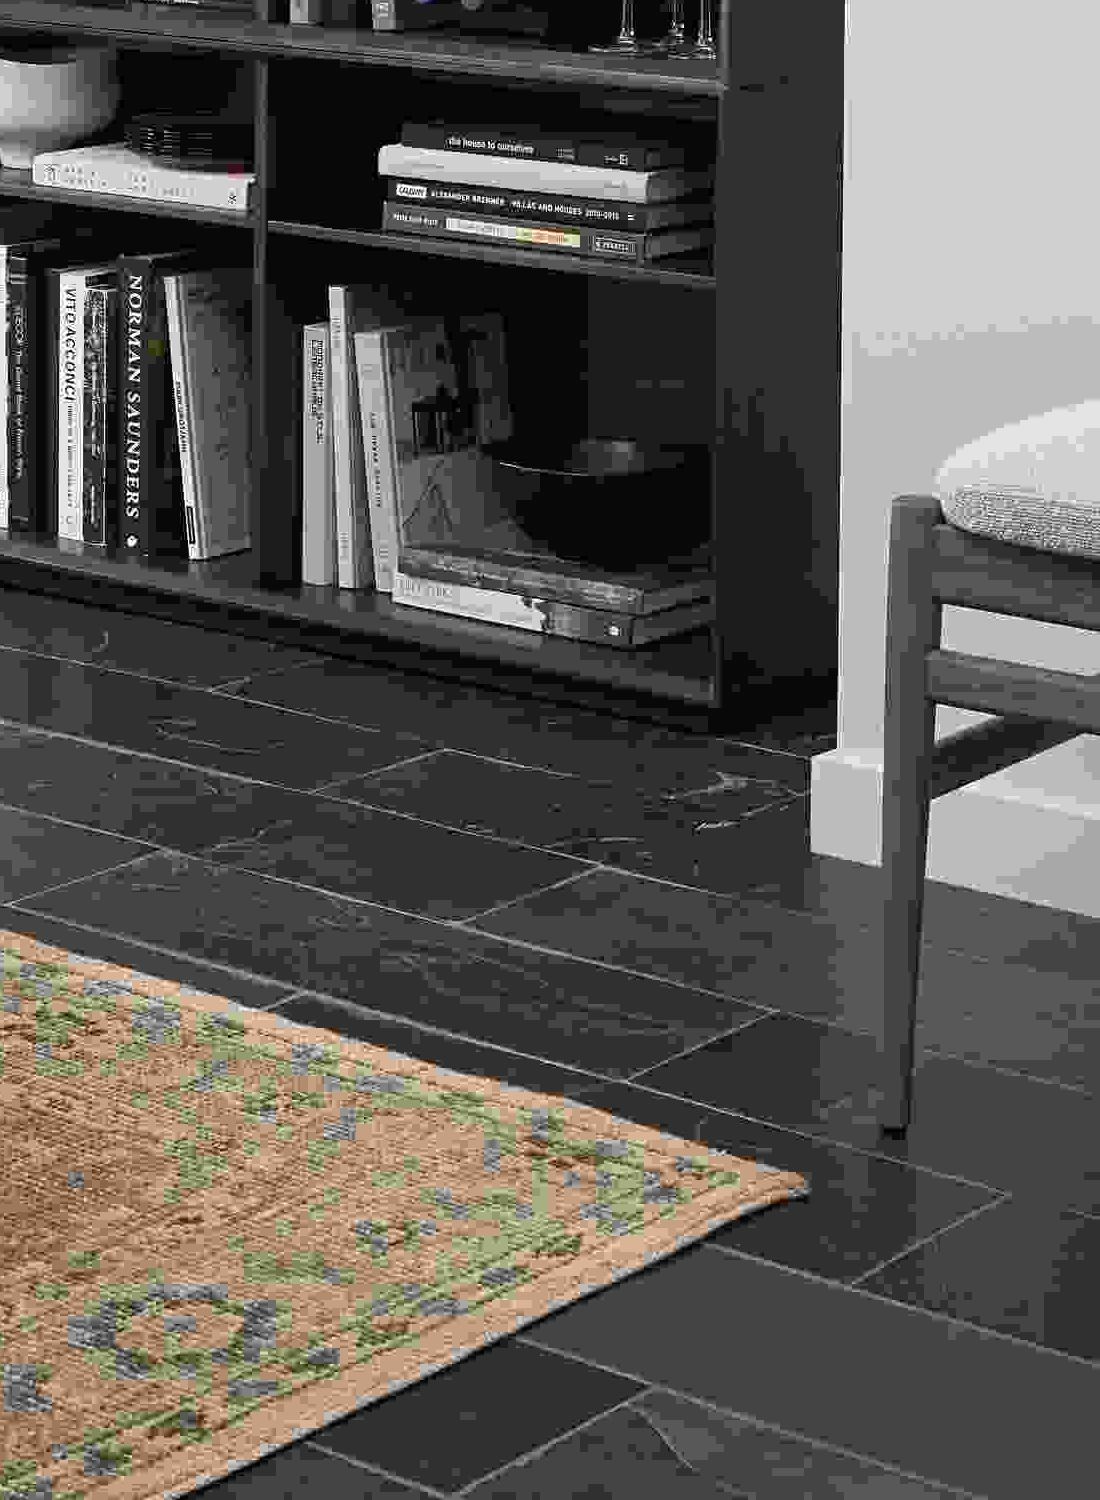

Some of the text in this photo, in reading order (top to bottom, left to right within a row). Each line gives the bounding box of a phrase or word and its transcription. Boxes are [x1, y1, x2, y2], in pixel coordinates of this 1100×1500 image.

[64, 287, 77, 324] VITO
[63, 326, 77, 401] ACCONCI
[126, 275, 142, 518] NORMAN SAUNDERS
